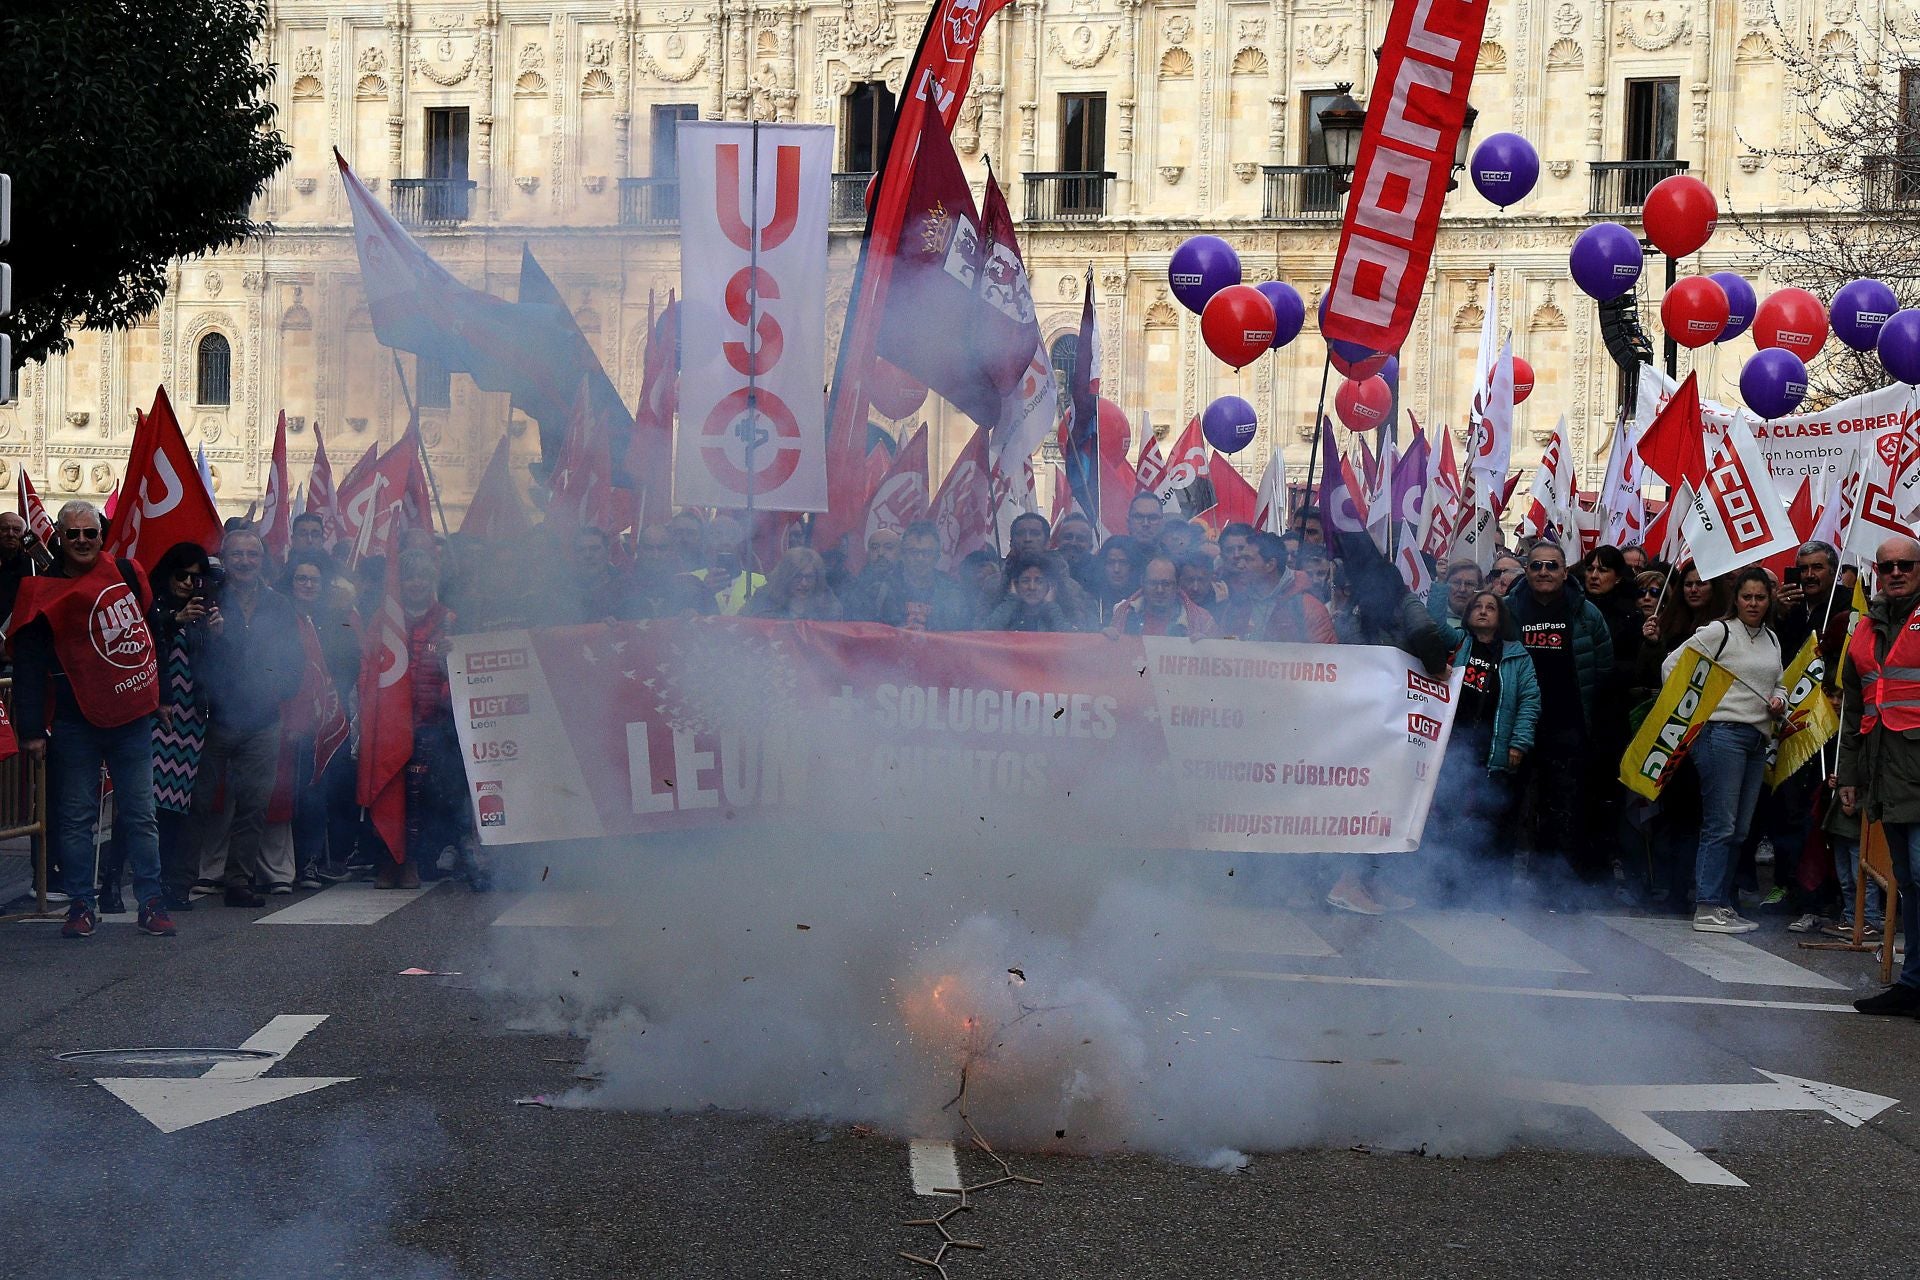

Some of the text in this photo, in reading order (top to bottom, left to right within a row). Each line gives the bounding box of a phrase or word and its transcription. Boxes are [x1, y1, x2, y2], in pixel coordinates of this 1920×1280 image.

[1481, 172, 1510, 181] CCOO
[1614, 266, 1638, 275] CCOO
[1173, 275, 1201, 284] CCOO
[702, 143, 801, 495] USO
[1856, 312, 1888, 323] CCOO
[1689, 321, 1718, 330] CCOO
[1245, 332, 1272, 341] CCOO
[1778, 331, 1811, 345] CCOO
[1355, 404, 1380, 418] CCOO
[1774, 422, 1832, 439] CLASE
[1786, 446, 1843, 460] hombro
[97, 592, 143, 630] UGT
[1909, 623, 1920, 631] CG
[1525, 633, 1562, 646] USO
[469, 653, 524, 671] CCOO
[1158, 655, 1337, 682] INFRAESTRUCTURAS
[115, 671, 147, 694] mano
[467, 674, 494, 685] León
[1410, 673, 1447, 699] CCOO
[1407, 690, 1429, 704] León
[473, 696, 508, 716] UGT
[876, 683, 1118, 740] SOLUCIONES
[1170, 705, 1244, 728] EMPLEO
[471, 719, 497, 730] León
[1411, 716, 1438, 738] UGT
[1408, 734, 1427, 749] León
[472, 739, 518, 760] USO
[1282, 759, 1370, 787] PÚBLICOS
[481, 811, 503, 822] CGT
